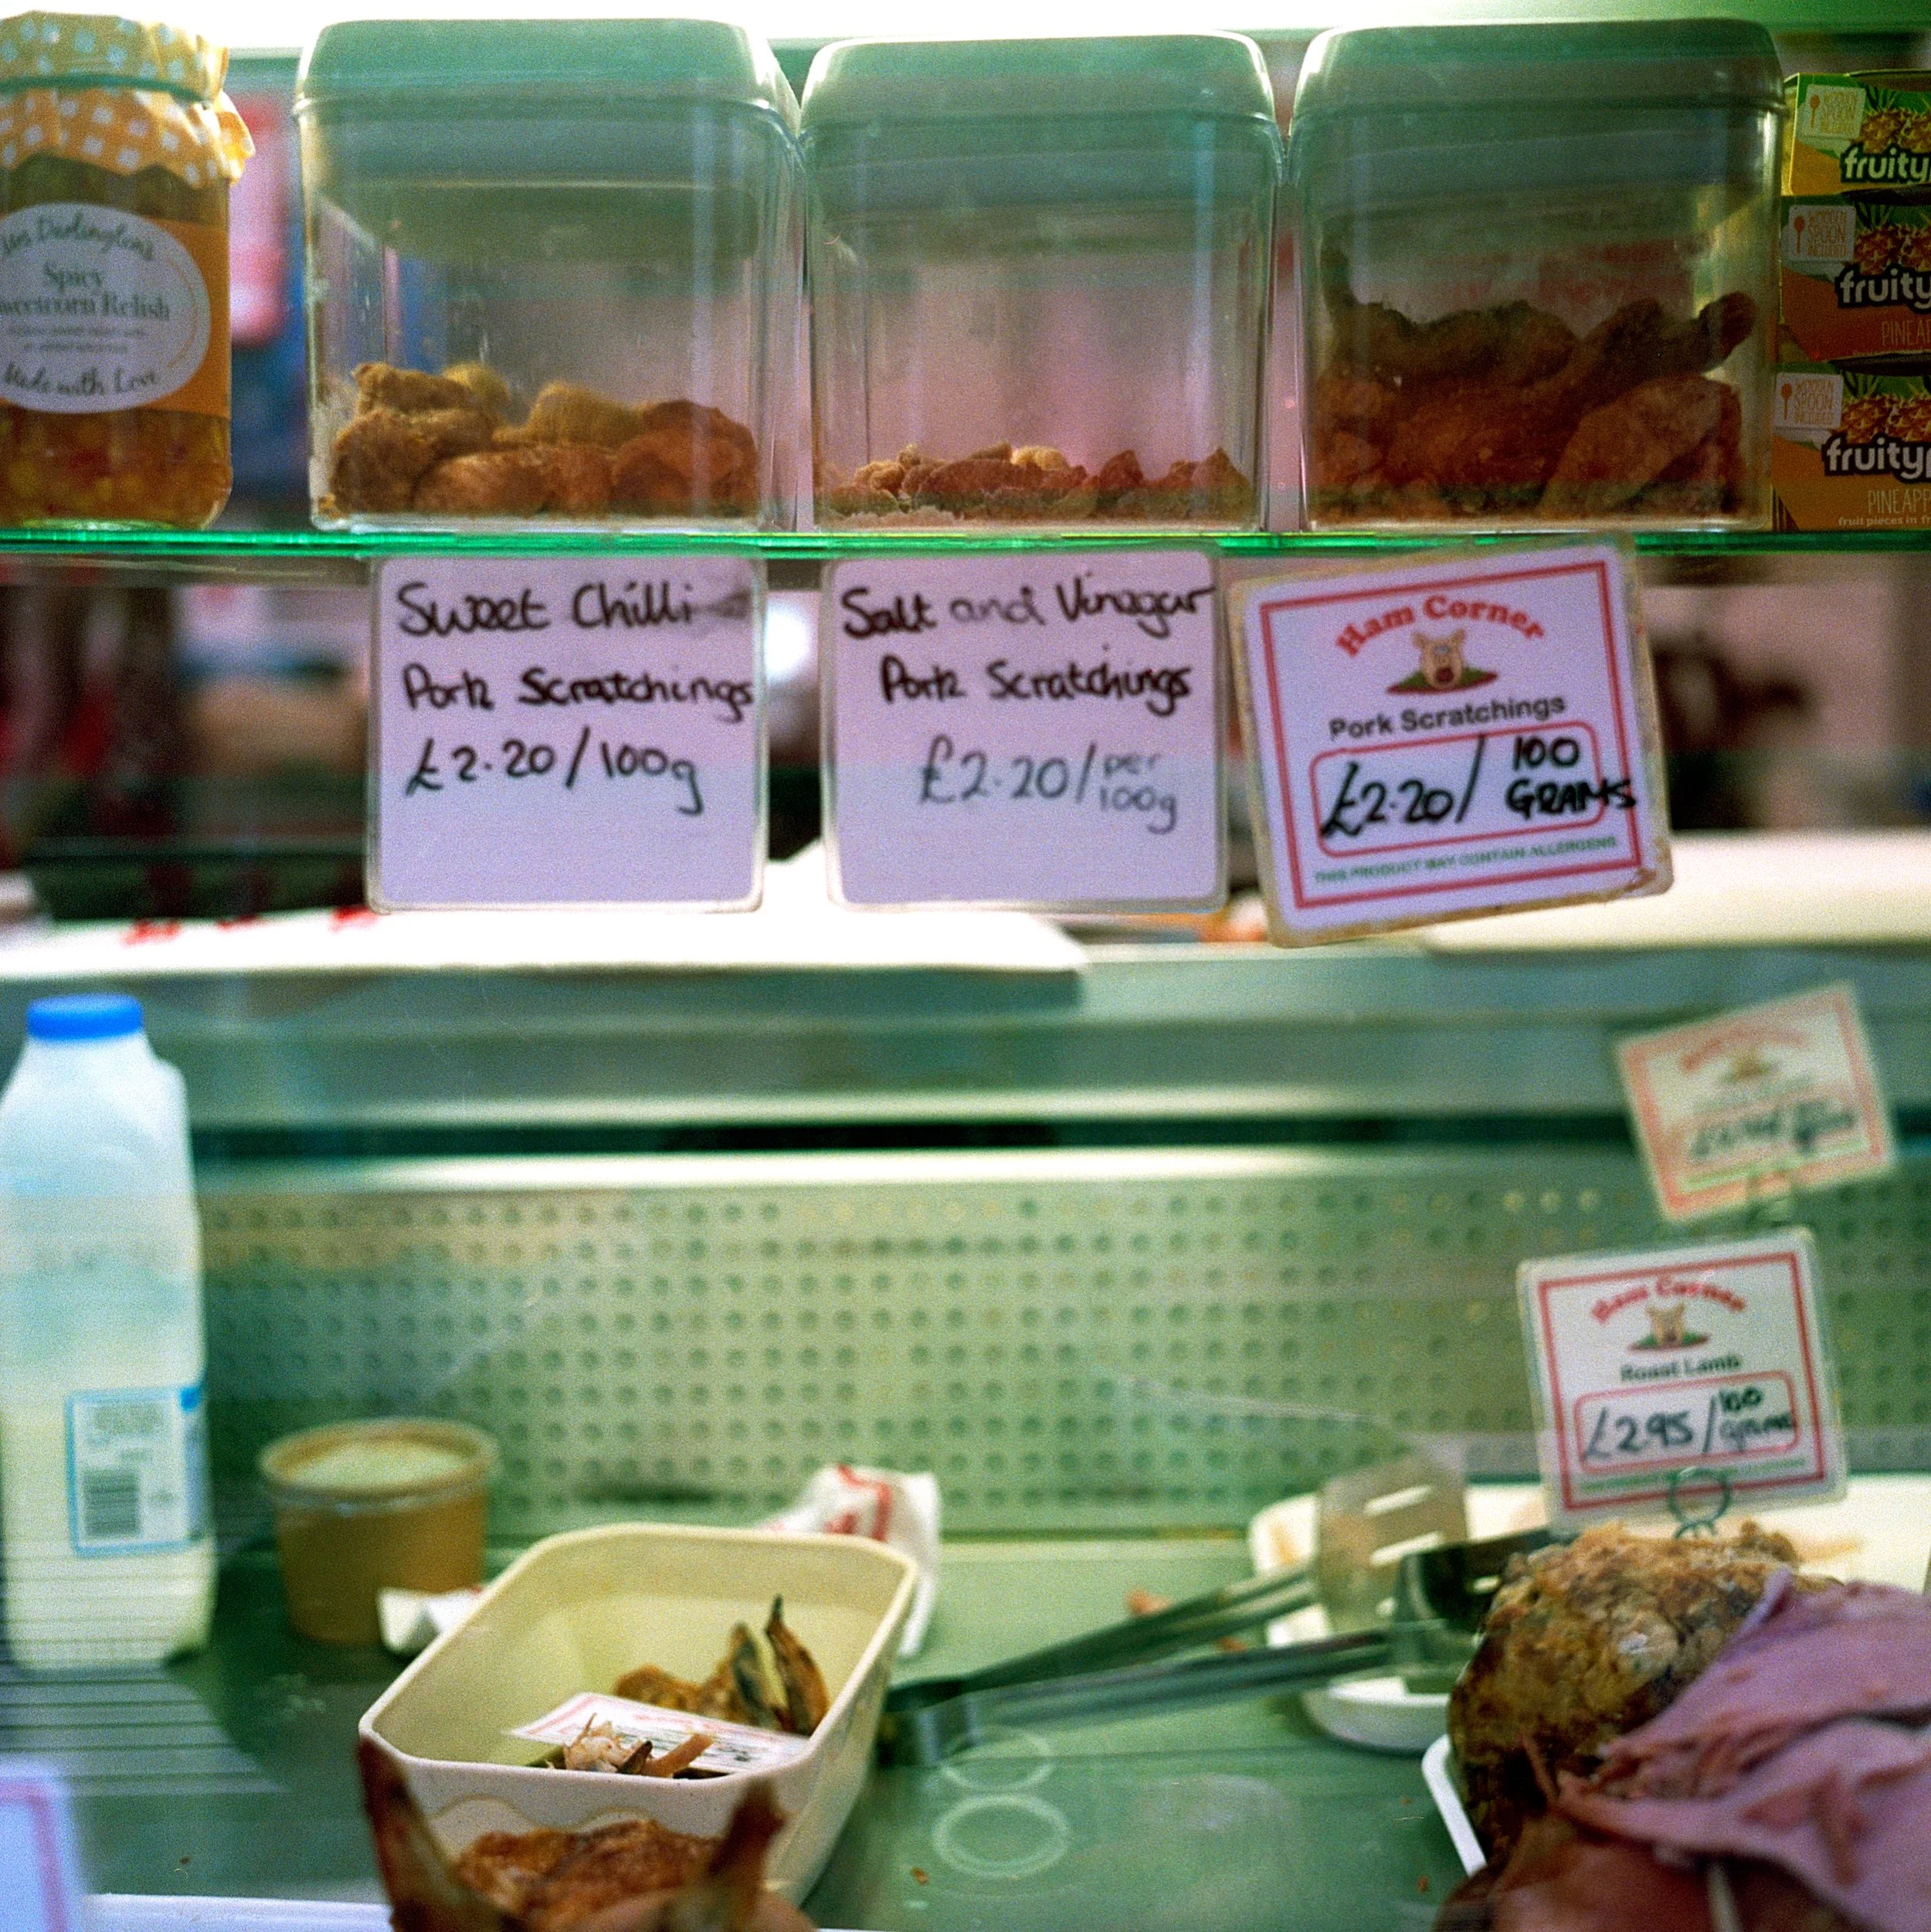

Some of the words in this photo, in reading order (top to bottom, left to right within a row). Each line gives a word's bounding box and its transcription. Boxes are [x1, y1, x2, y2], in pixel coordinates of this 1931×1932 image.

[1844, 147, 1931, 184] fruity
[1839, 267, 1931, 309] fruity
[396, 582, 551, 637] Sweet
[572, 581, 695, 629] Chilli
[840, 587, 937, 639] Salt
[950, 586, 1045, 626] and
[1335, 604, 1415, 658] Ham
[1422, 595, 1545, 640] Corner
[402, 662, 496, 711] Pork
[518, 665, 755, 723] Scratchings
[881, 654, 960, 705] Pork
[986, 643, 1193, 717] Scratchings
[1329, 711, 1393, 742] Pork
[1400, 696, 1566, 733] Scratchings
[1513, 735, 1581, 772] 100
[1505, 778, 1637, 820] GRAMS
